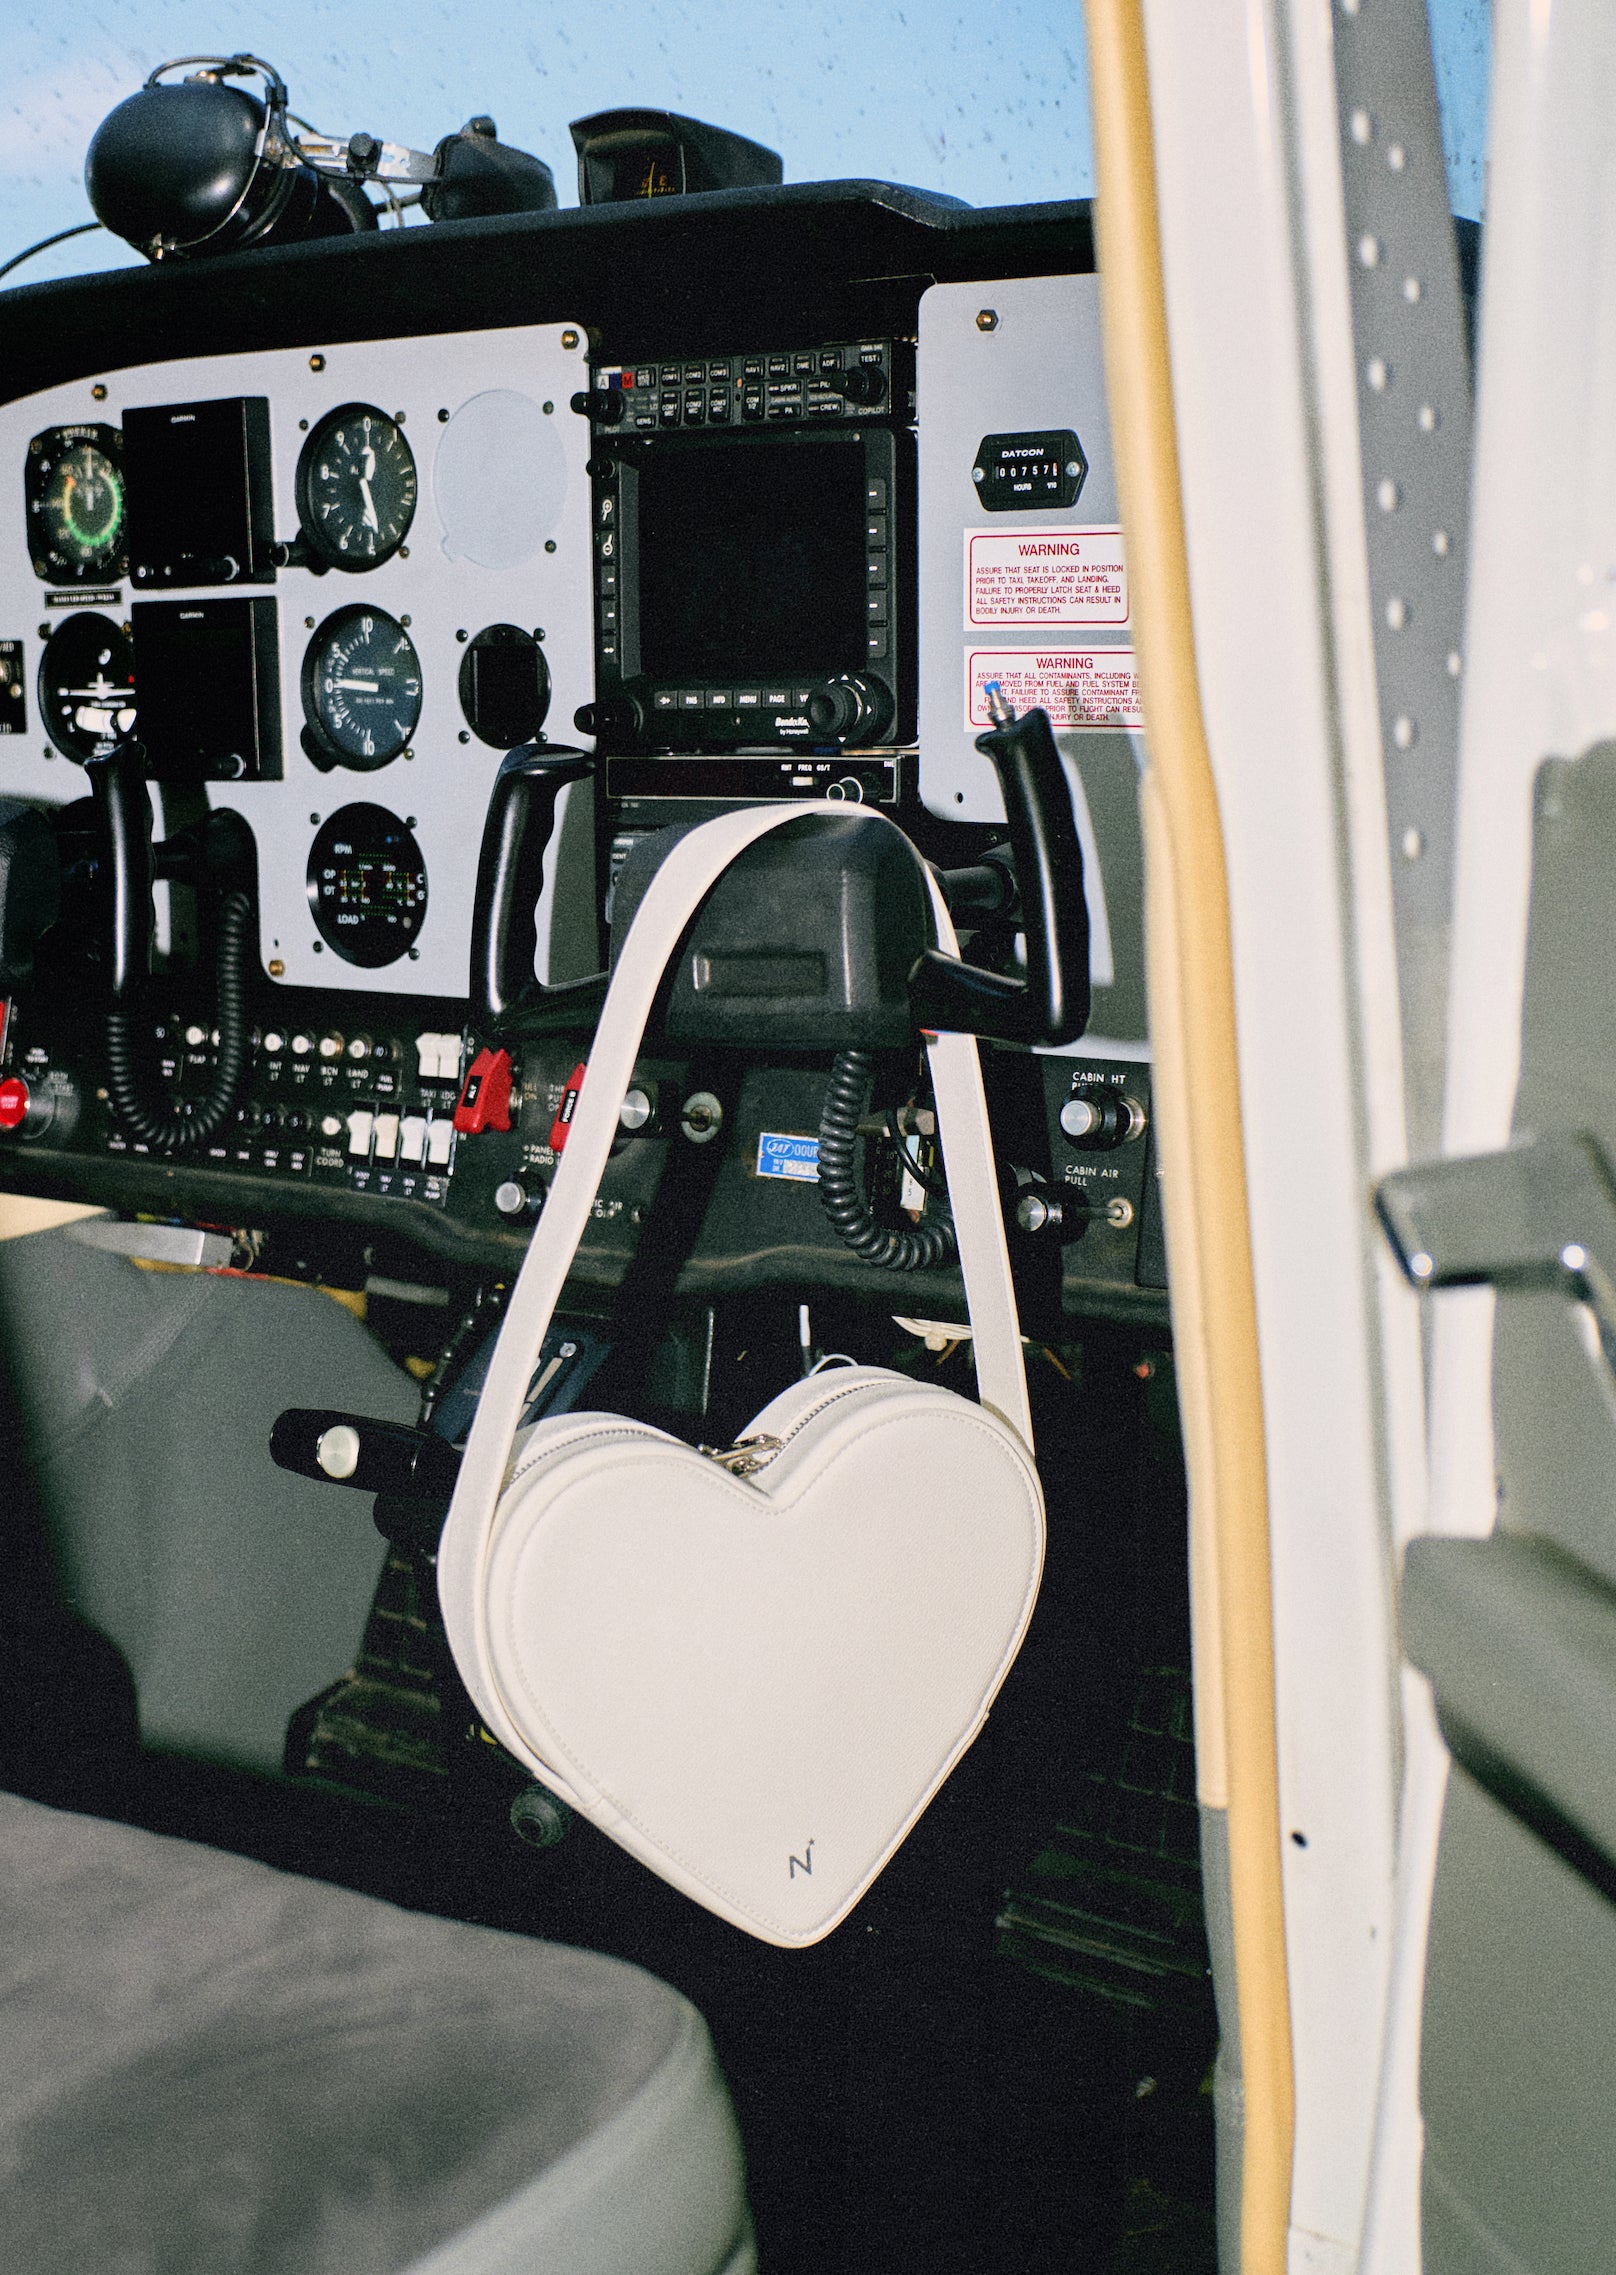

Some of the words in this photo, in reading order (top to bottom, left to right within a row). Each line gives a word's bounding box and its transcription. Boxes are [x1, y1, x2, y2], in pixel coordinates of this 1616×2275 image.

[822, 359, 834, 367] ADF
[861, 355, 877, 363] TEST
[797, 362, 810, 370] DME
[600, 375, 606, 387] A
[623, 374, 632, 385] M
[780, 384, 797, 392] SPKR
[820, 403, 838, 411] CREW
[858, 406, 885, 415] COPILOT
[335, 431, 345, 447] 9
[1001, 448, 1044, 458] DATCON
[320, 463, 329, 480] 8
[1013, 482, 1032, 492] HOURS
[322, 502, 330, 519] 7
[339, 535, 348, 550] 6
[1018, 543, 1080, 556] WARNING
[976, 566, 1002, 574] ASSURE
[1005, 566, 1020, 574] THAT
[1023, 566, 1040, 574] SEAT
[1082, 565, 1089, 573] IN
[1091, 565, 1123, 573] POSITION
[976, 577, 995, 585] PRIOR
[1061, 576, 1075, 584] AND
[976, 587, 1001, 595] FAILURE
[1004, 587, 1012, 595] TO
[1051, 586, 1072, 594] LATCH
[1075, 586, 1091, 594] SEAT
[1086, 596, 1111, 604] RESULT
[1000, 607, 1023, 615] INJURY
[1026, 607, 1035, 615] OR
[361, 616, 373, 632] 10
[331, 642, 341, 658] 5
[1036, 657, 1093, 669] WARNING
[352, 668, 375, 676] VERTICAL
[378, 668, 395, 676] SPEED
[1094, 672, 1131, 680] INCLUDING
[325, 682, 334, 693] 0
[739, 696, 757, 704] MENU
[769, 695, 785, 703] PAGE
[334, 714, 343, 729] 5
[363, 742, 375, 756] 10
[334, 843, 352, 855] RPM
[323, 869, 336, 879] OP
[323, 885, 336, 895] OT
[337, 914, 359, 925] LOAD
[269, 1061, 282, 1070] INT
[292, 1064, 311, 1073] NAV
[346, 1069, 369, 1079] LAND
[1072, 1072, 1105, 1083] CABIN
[1111, 1075, 1126, 1085] HT
[420, 1088, 437, 1098] TAXI
[441, 1090, 456, 1100] LDG
[321, 1147, 341, 1157] TURN
[530, 1144, 554, 1156] PANEL
[769, 1142, 792, 1155] JAT
[315, 1156, 345, 1168] COORD
[529, 1154, 554, 1166] RADIO
[1065, 1165, 1097, 1176] CABIN
[1101, 1169, 1119, 1179] AIR
[1064, 1176, 1087, 1187] PULL
